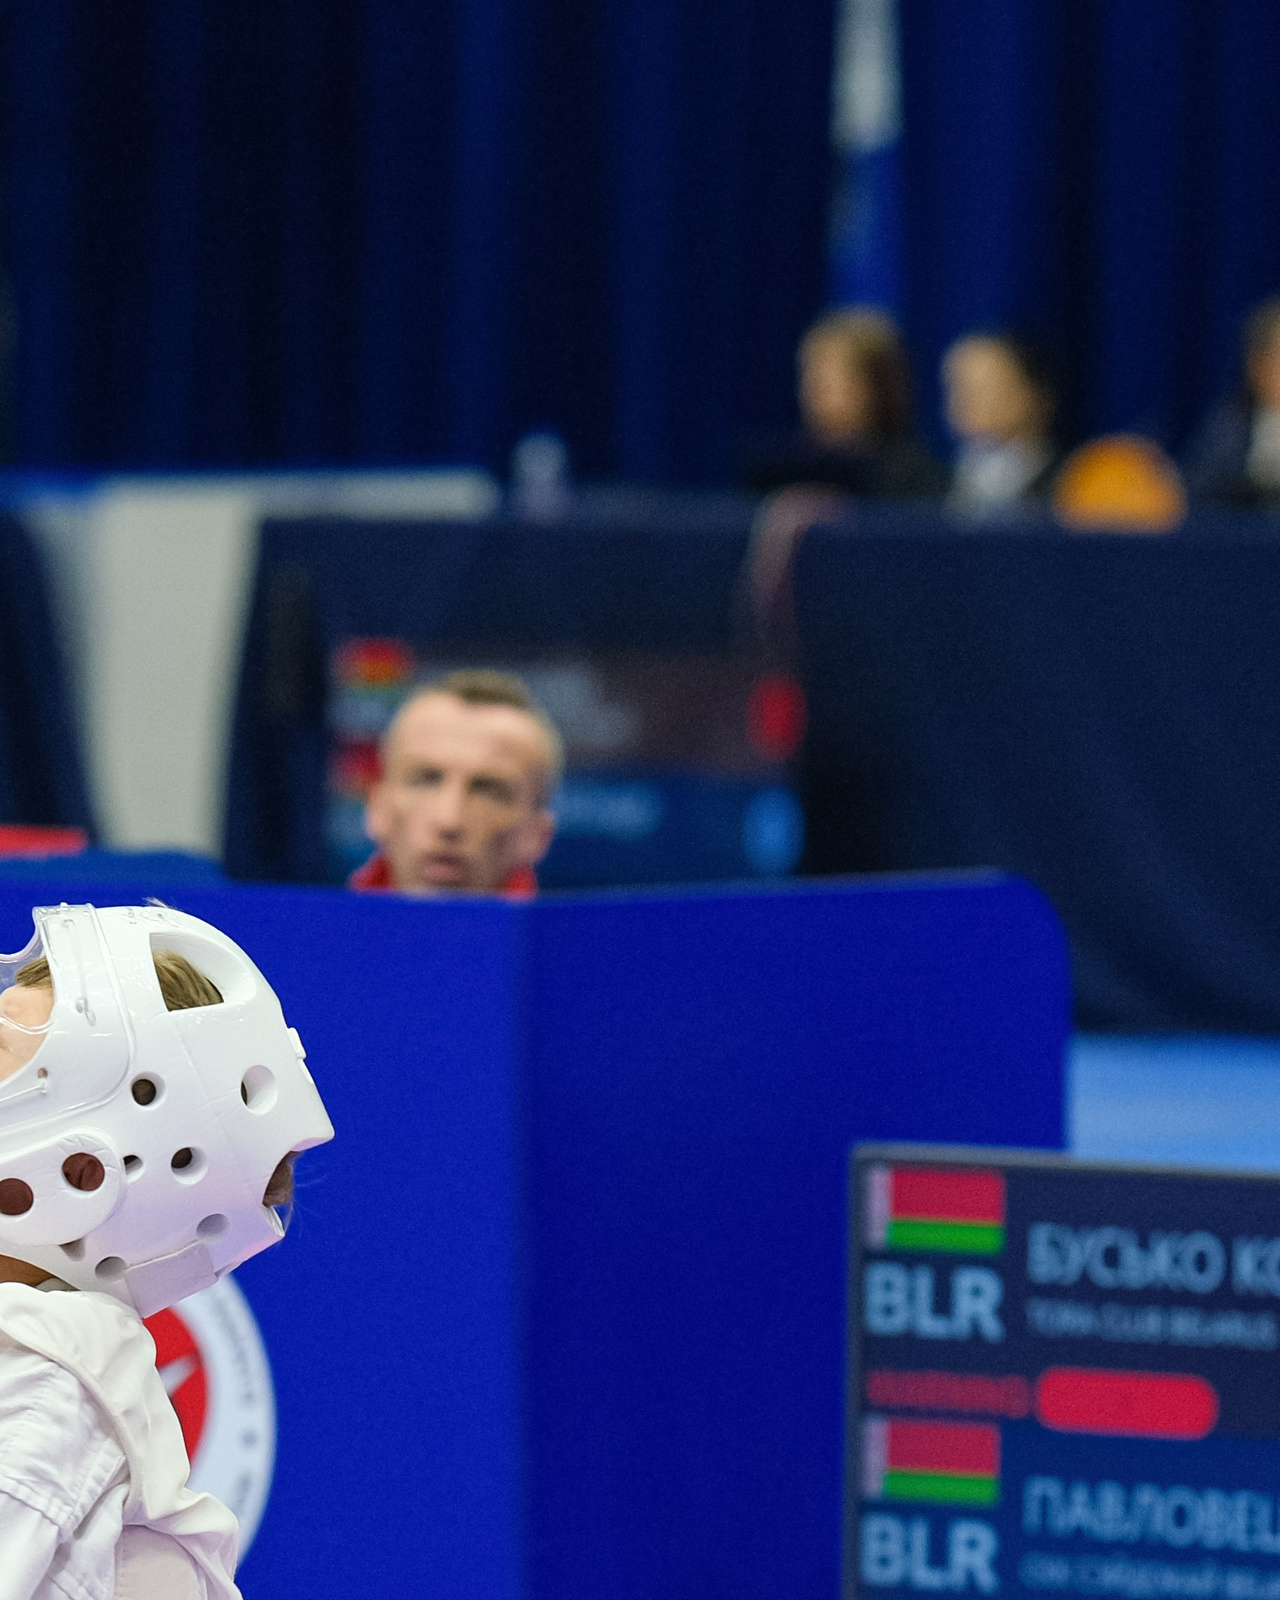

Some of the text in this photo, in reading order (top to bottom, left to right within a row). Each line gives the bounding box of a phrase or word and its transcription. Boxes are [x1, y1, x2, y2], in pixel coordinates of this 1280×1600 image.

[1027, 1222, 1226, 1292] БУСЬКО
[865, 1262, 1004, 1341] BLR
[860, 1513, 999, 1593] BLR
